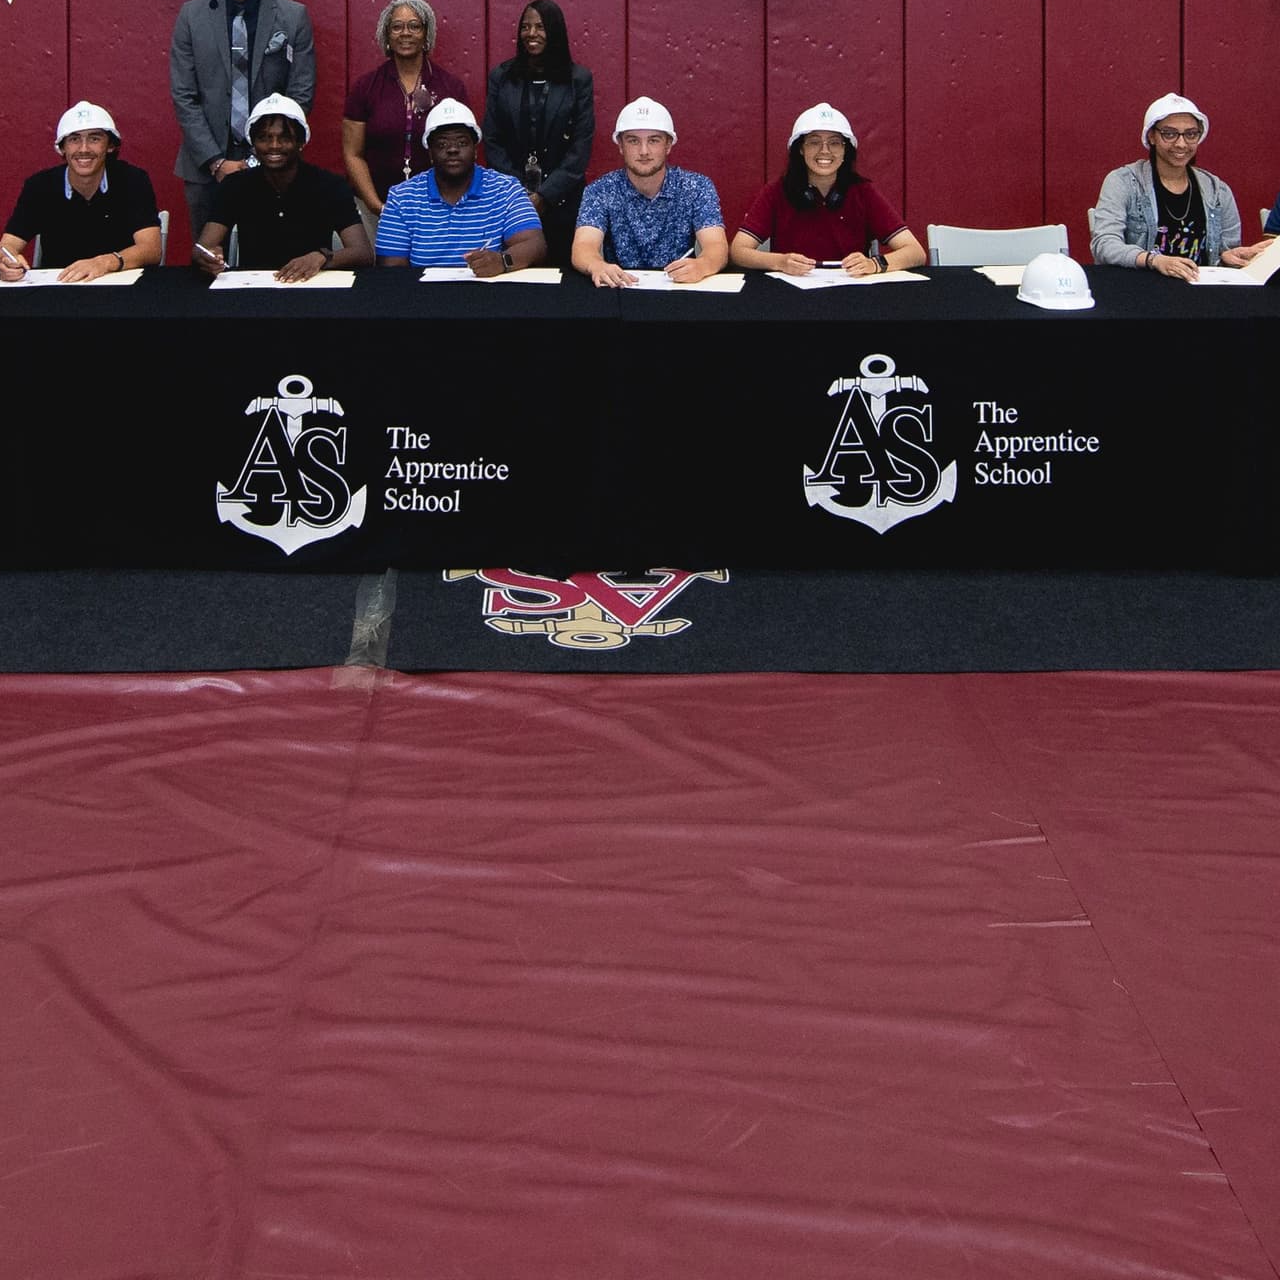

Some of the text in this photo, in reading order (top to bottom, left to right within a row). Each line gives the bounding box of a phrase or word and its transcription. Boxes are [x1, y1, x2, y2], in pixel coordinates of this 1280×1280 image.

[972, 401, 1018, 424] The
[386, 426, 431, 450] The
[806, 385, 941, 508] AS
[973, 428, 1100, 459] Apprentice
[219, 406, 351, 529] AS
[384, 455, 509, 485] Apprentice
[974, 460, 1052, 486] School
[383, 487, 461, 513] School
